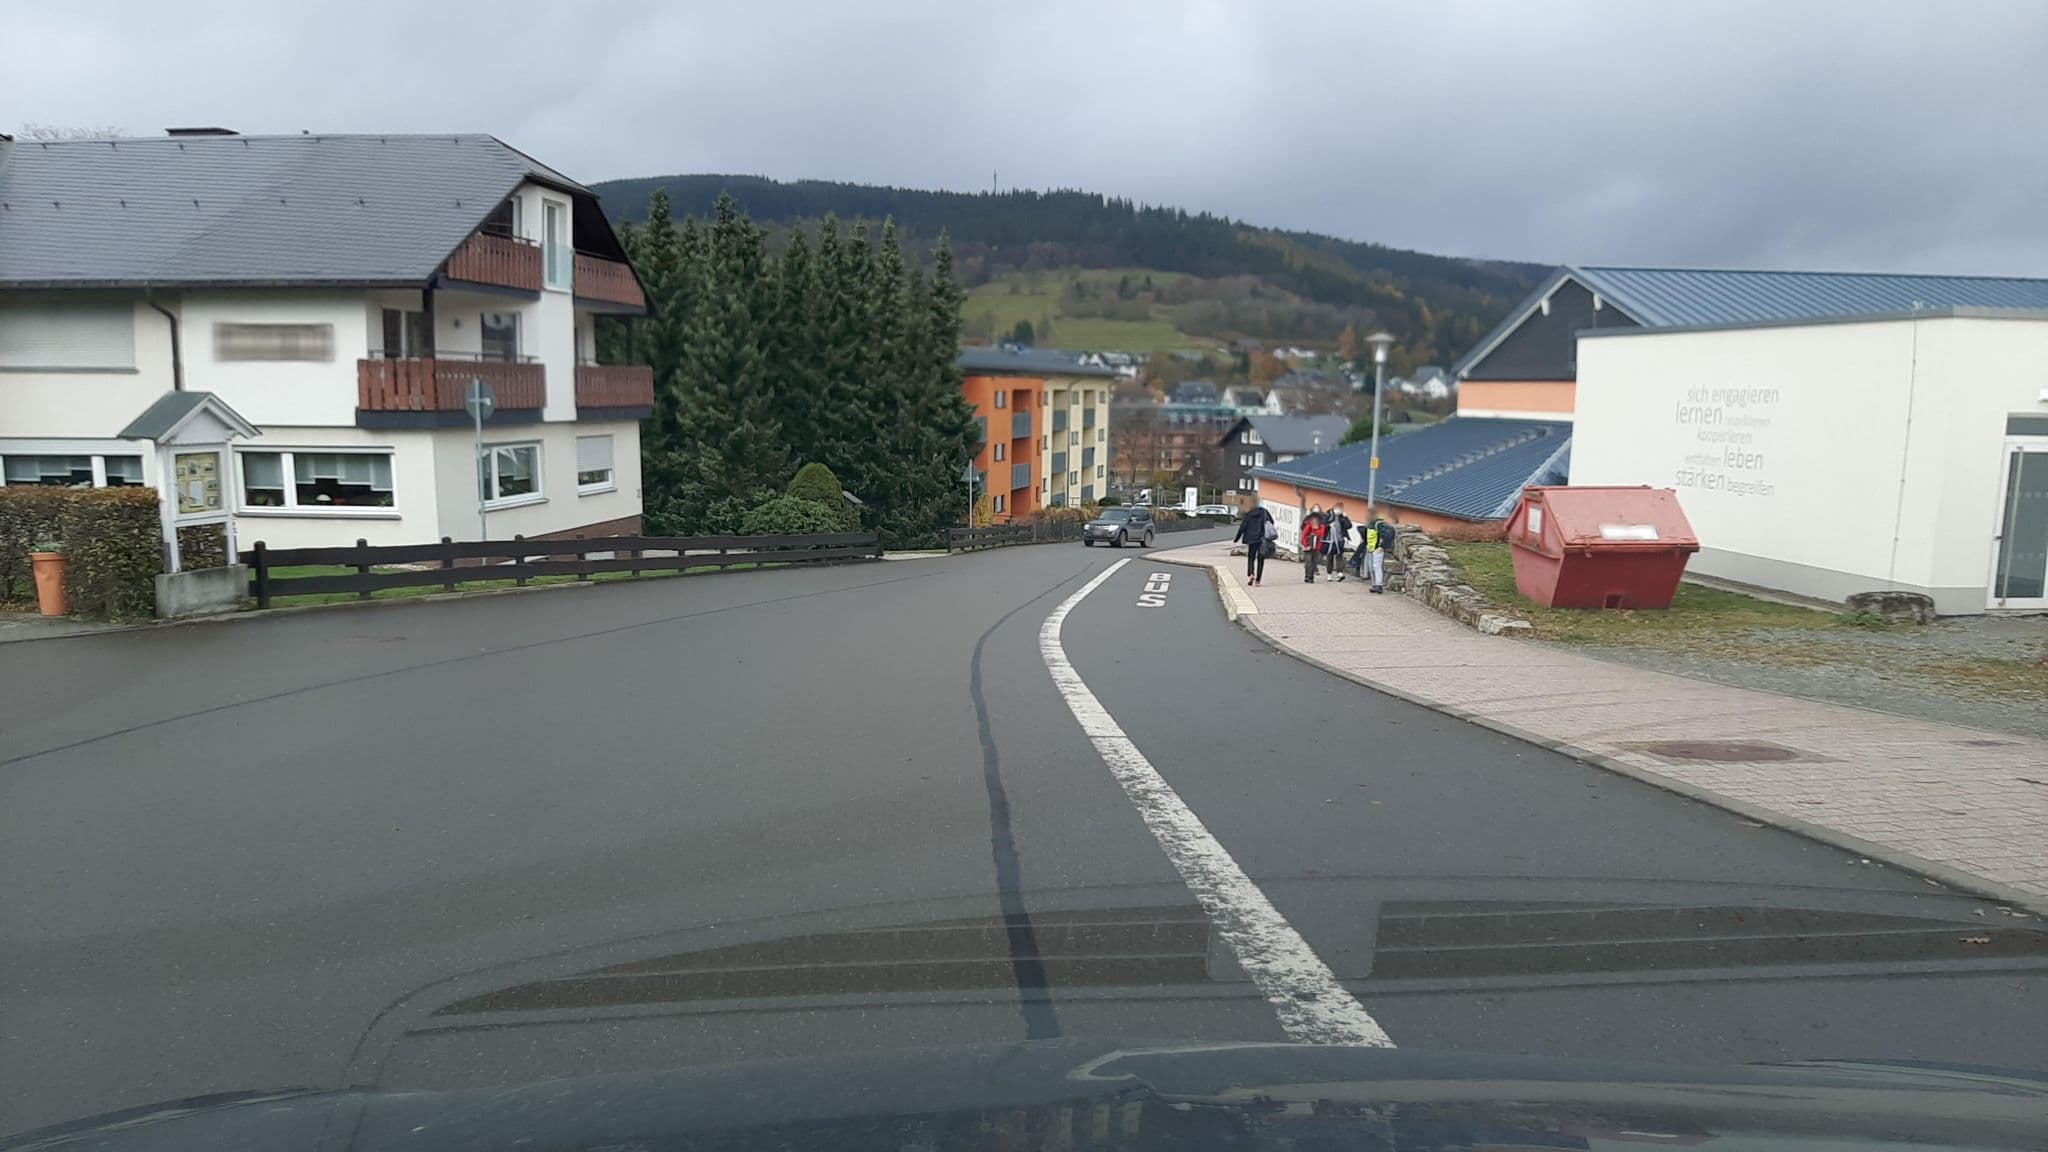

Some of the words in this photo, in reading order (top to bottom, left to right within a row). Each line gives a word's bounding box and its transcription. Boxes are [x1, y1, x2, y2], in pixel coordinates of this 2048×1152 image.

[1687, 384, 1709, 403] sich
[1712, 385, 1780, 408] engagieren
[1675, 400, 1722, 424] lernen
[1724, 445, 1763, 470] leben
[1136, 573, 1171, 607] BUS
